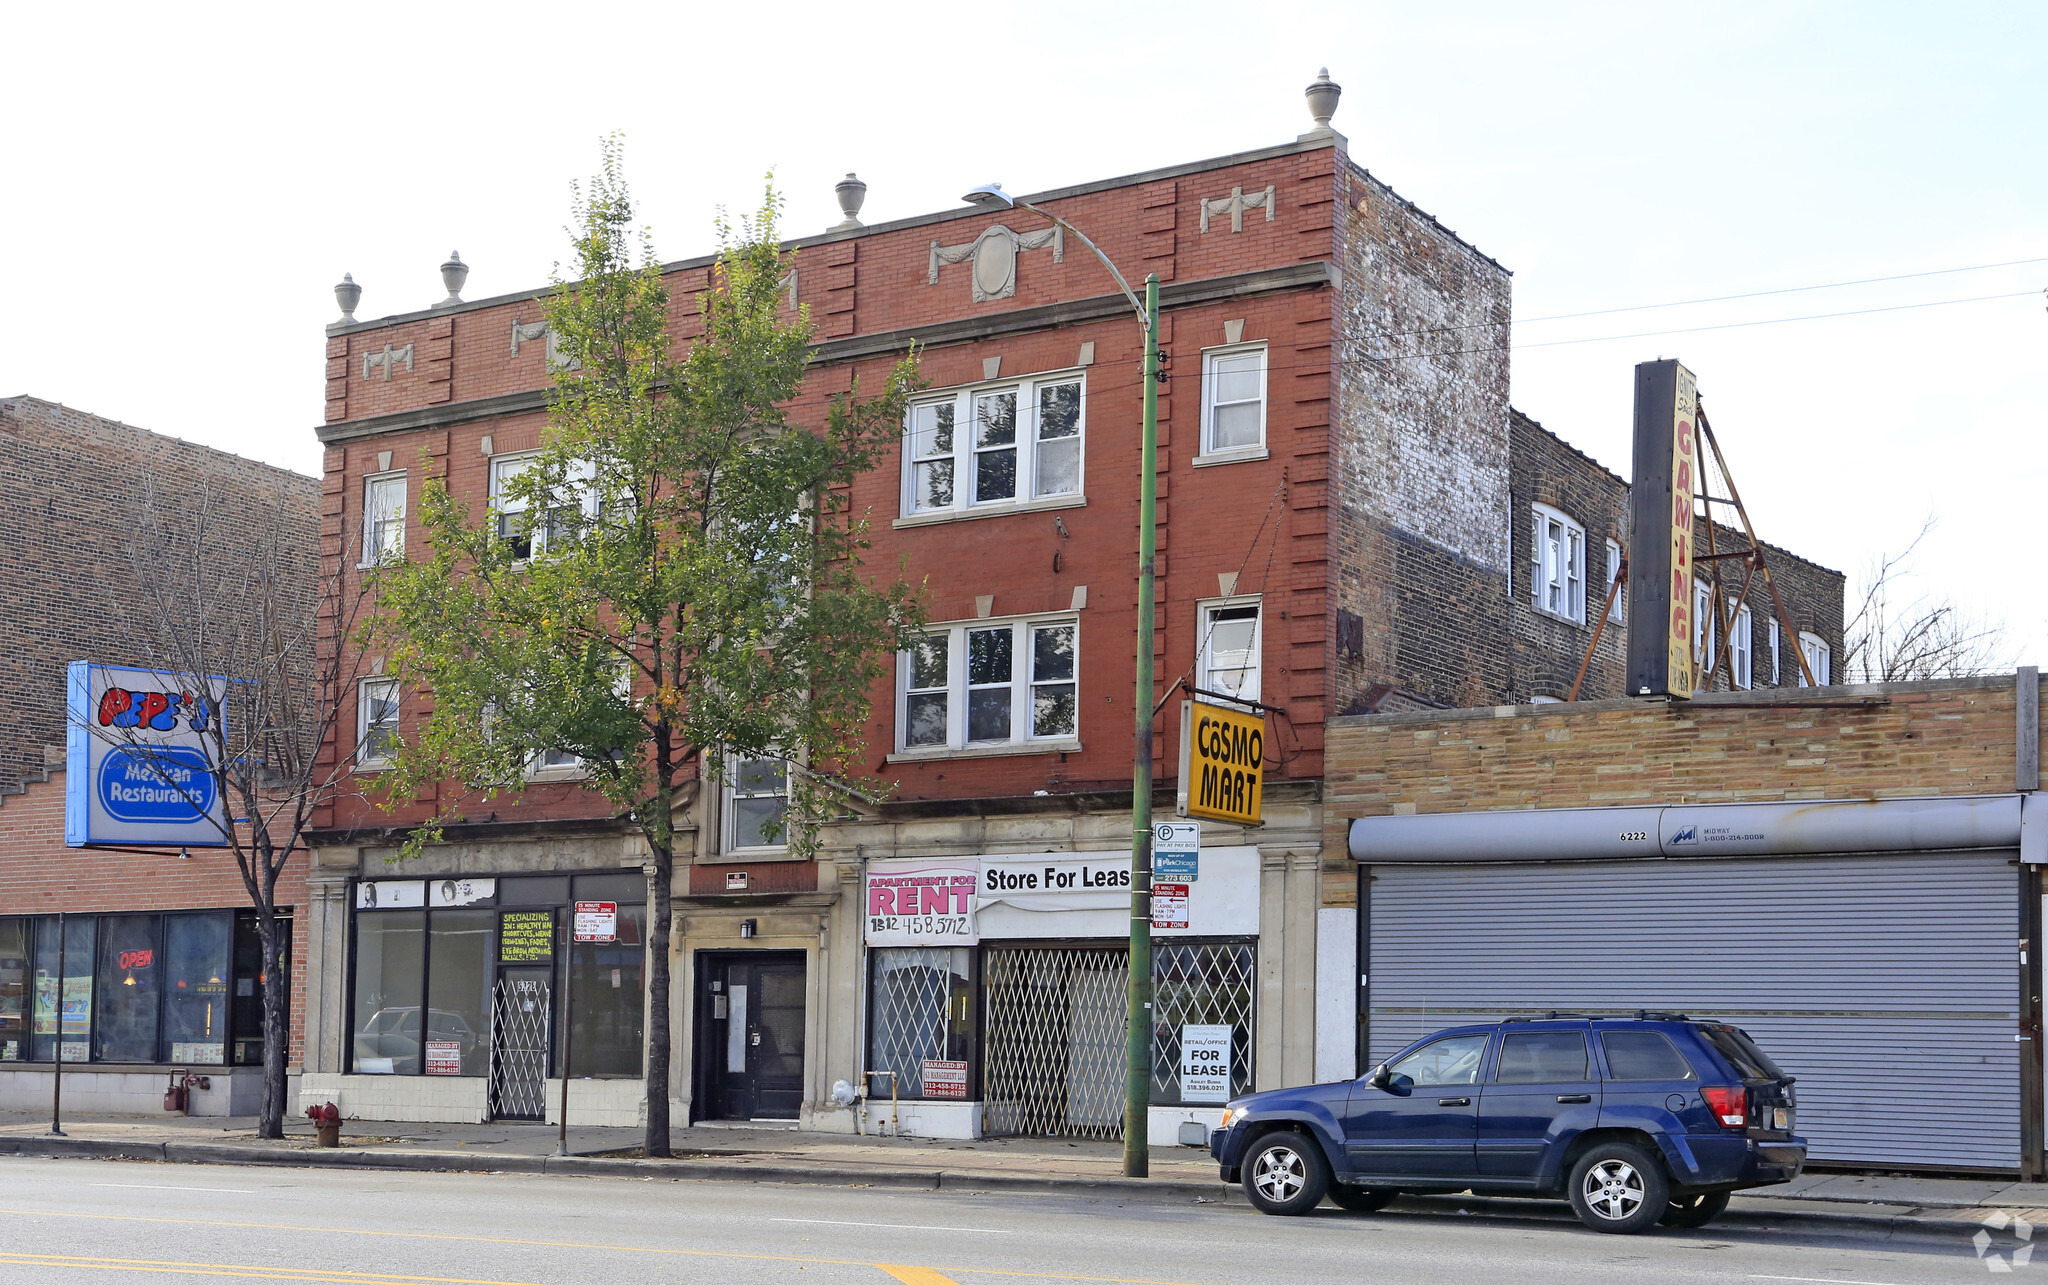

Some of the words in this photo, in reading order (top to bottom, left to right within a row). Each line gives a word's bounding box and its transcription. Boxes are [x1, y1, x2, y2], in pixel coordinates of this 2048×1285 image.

[1673, 420, 1692, 641] GAMING
[98, 687, 210, 732] PEPE'S
[1198, 716, 1263, 769] COSMO
[125, 763, 191, 787] Mexican
[111, 782, 203, 805] Restaurants
[1200, 763, 1256, 815] MART
[1620, 832, 1647, 841] 6222
[869, 876, 948, 887] APARTMENT
[951, 876, 976, 885] FOR
[986, 869, 1038, 890] Store
[1044, 867, 1076, 889] For
[1082, 866, 1132, 887] Leas
[869, 886, 975, 915] RENT
[504, 913, 549, 922] SPECIALIZING
[903, 916, 933, 935] 458
[935, 917, 970, 935] 5712
[119, 949, 153, 969] OPEN
[1184, 1038, 1227, 1046] RETAIL/OFFICE
[1191, 1050, 1220, 1060] FOR
[1183, 1065, 1227, 1075] LEASE
[925, 1089, 966, 1097] 773-886-6125
